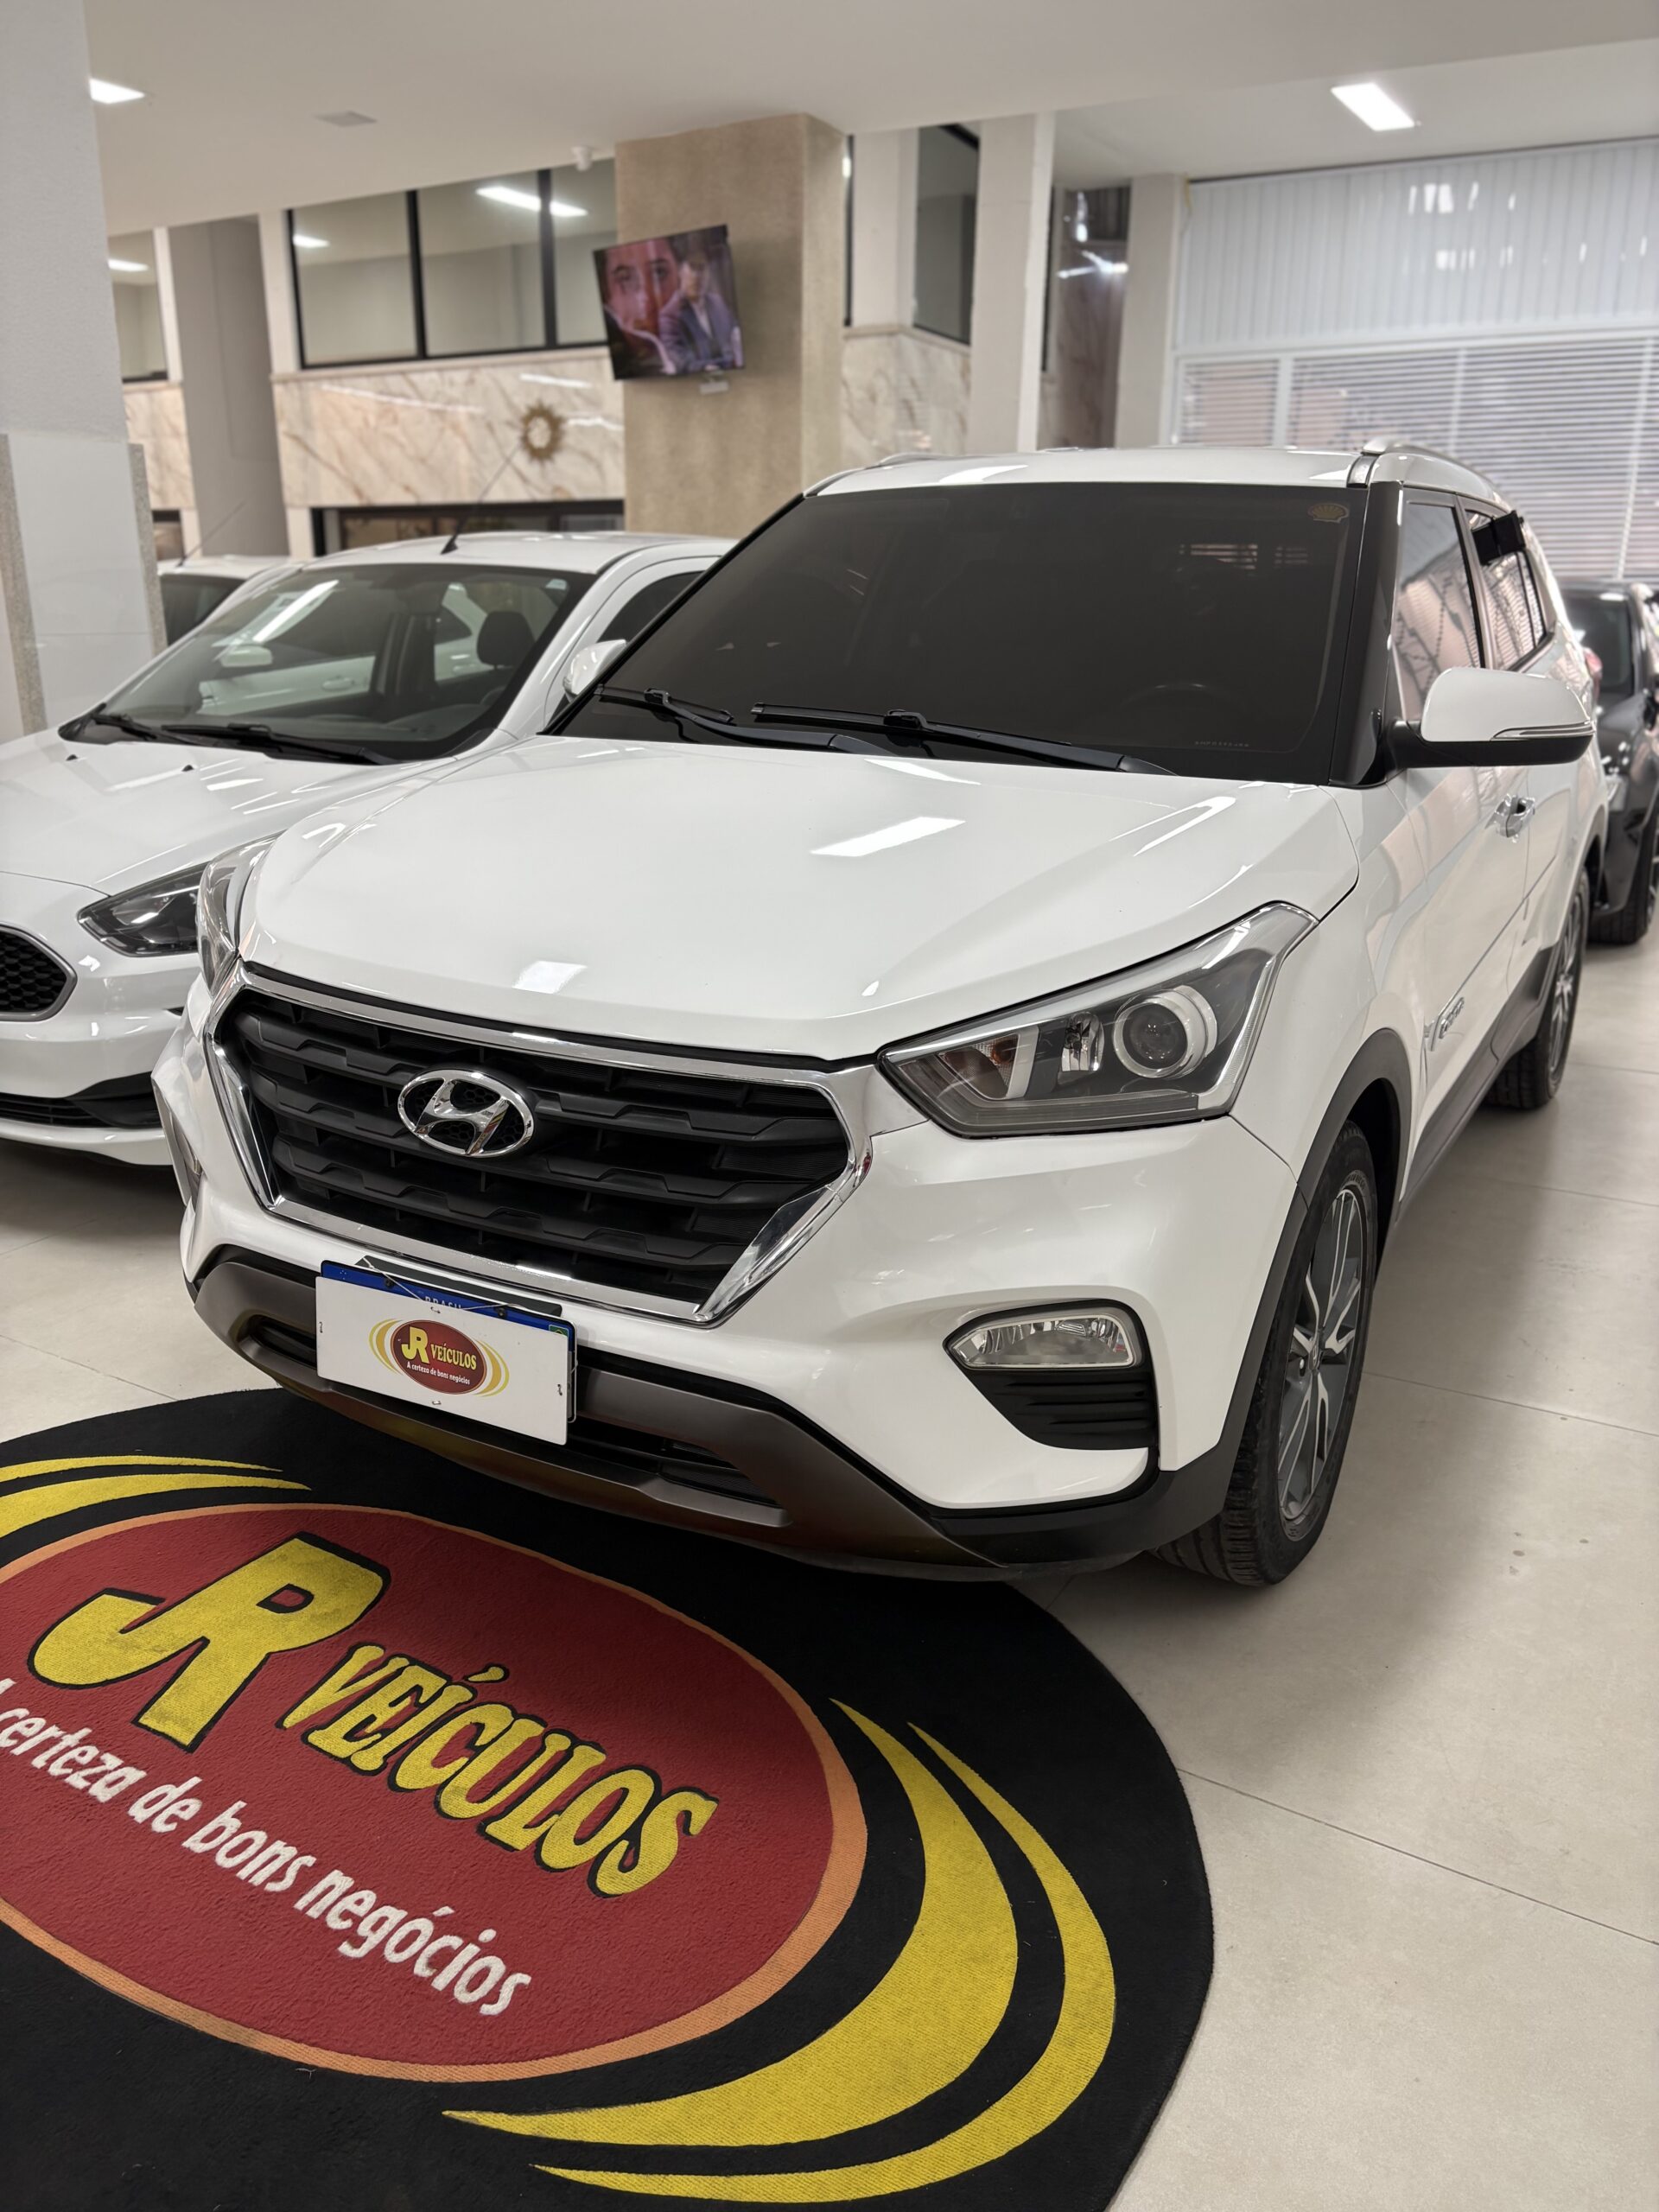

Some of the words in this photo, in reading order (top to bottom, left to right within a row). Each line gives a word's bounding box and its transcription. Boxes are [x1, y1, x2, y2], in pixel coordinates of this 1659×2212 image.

[400, 1325, 430, 1364] JR
[430, 1342, 477, 1370] VEÍCULOS
[411, 1363, 429, 1374] certeza
[429, 1367, 436, 1376] de
[436, 1369, 448, 1379] bons
[448, 1374, 470, 1385] negócios
[27, 1531, 391, 1752] JR
[281, 1642, 721, 1897] VEÍCULOS
[127, 1776, 203, 1834] de
[181, 1800, 317, 1892] bons
[293, 1869, 532, 2016] negócios
